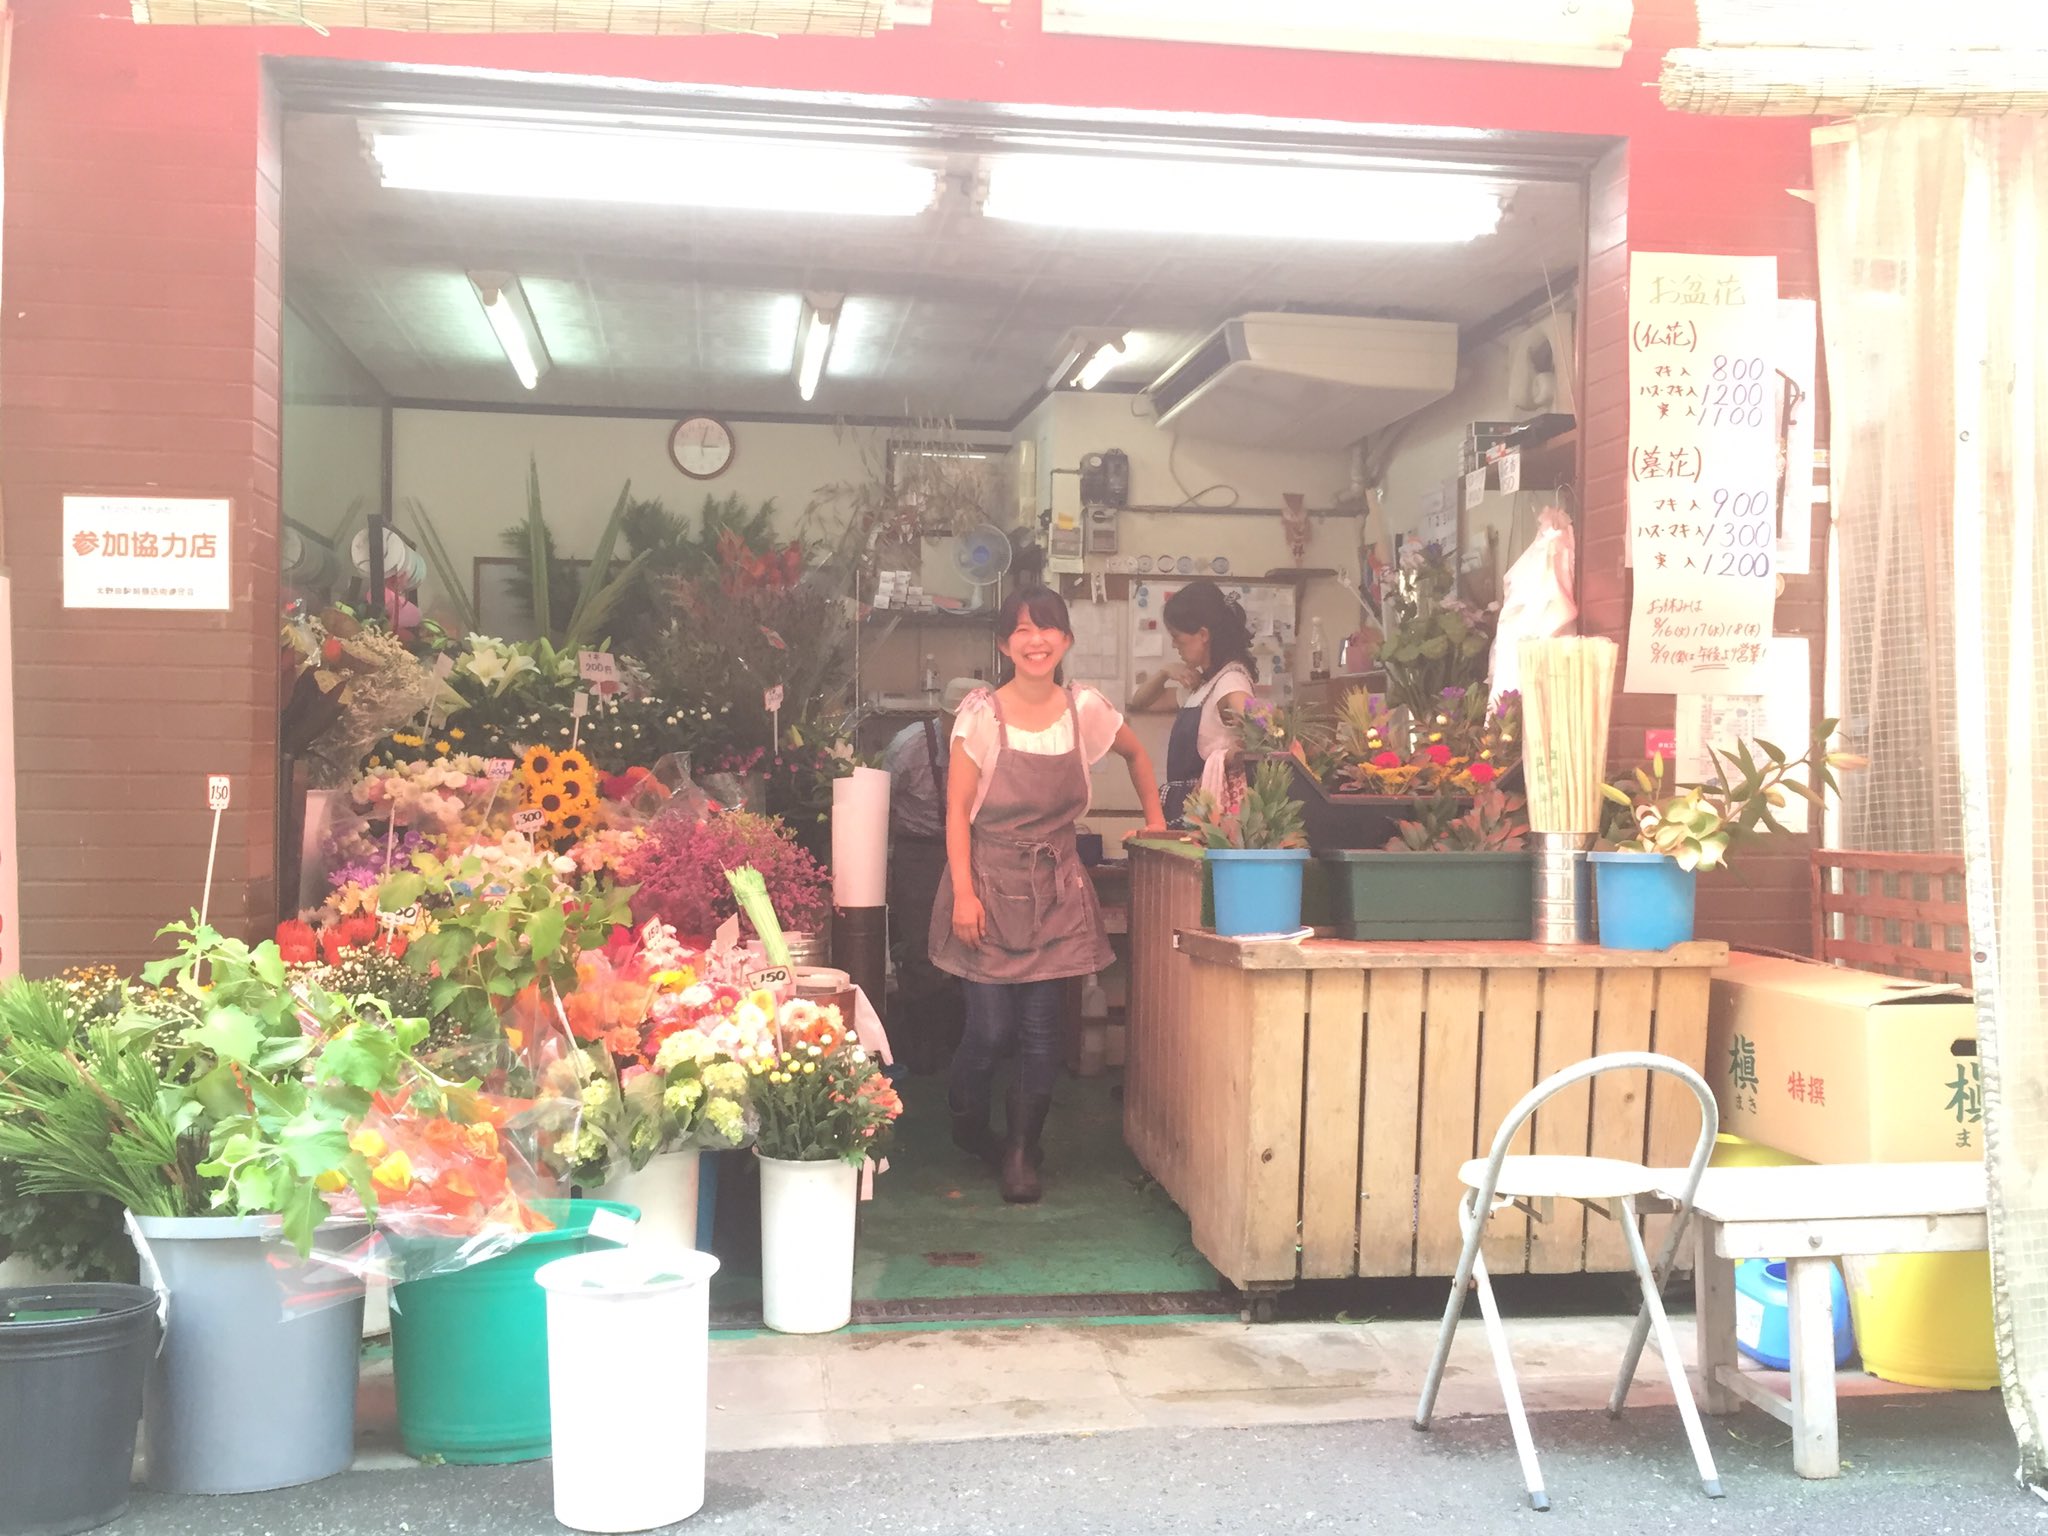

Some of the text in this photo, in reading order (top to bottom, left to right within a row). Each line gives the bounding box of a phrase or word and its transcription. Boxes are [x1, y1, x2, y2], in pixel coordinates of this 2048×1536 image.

[1650, 274, 1746, 306] お盆花
[1633, 320, 1697, 352] (仏花)
[1712, 355, 1764, 381] 800
[1701, 382, 1763, 406] 1200
[1698, 407, 1763, 427] 1100
[1632, 446, 1702, 483] (墓花)
[1713, 488, 1769, 518] 900
[72, 530, 217, 559] 参加協力店
[1702, 521, 1771, 548] 1300
[1703, 552, 1770, 578] 1200
[211, 785, 229, 800] 150
[520, 810, 543, 825] 300
[760, 970, 787, 983] 150
